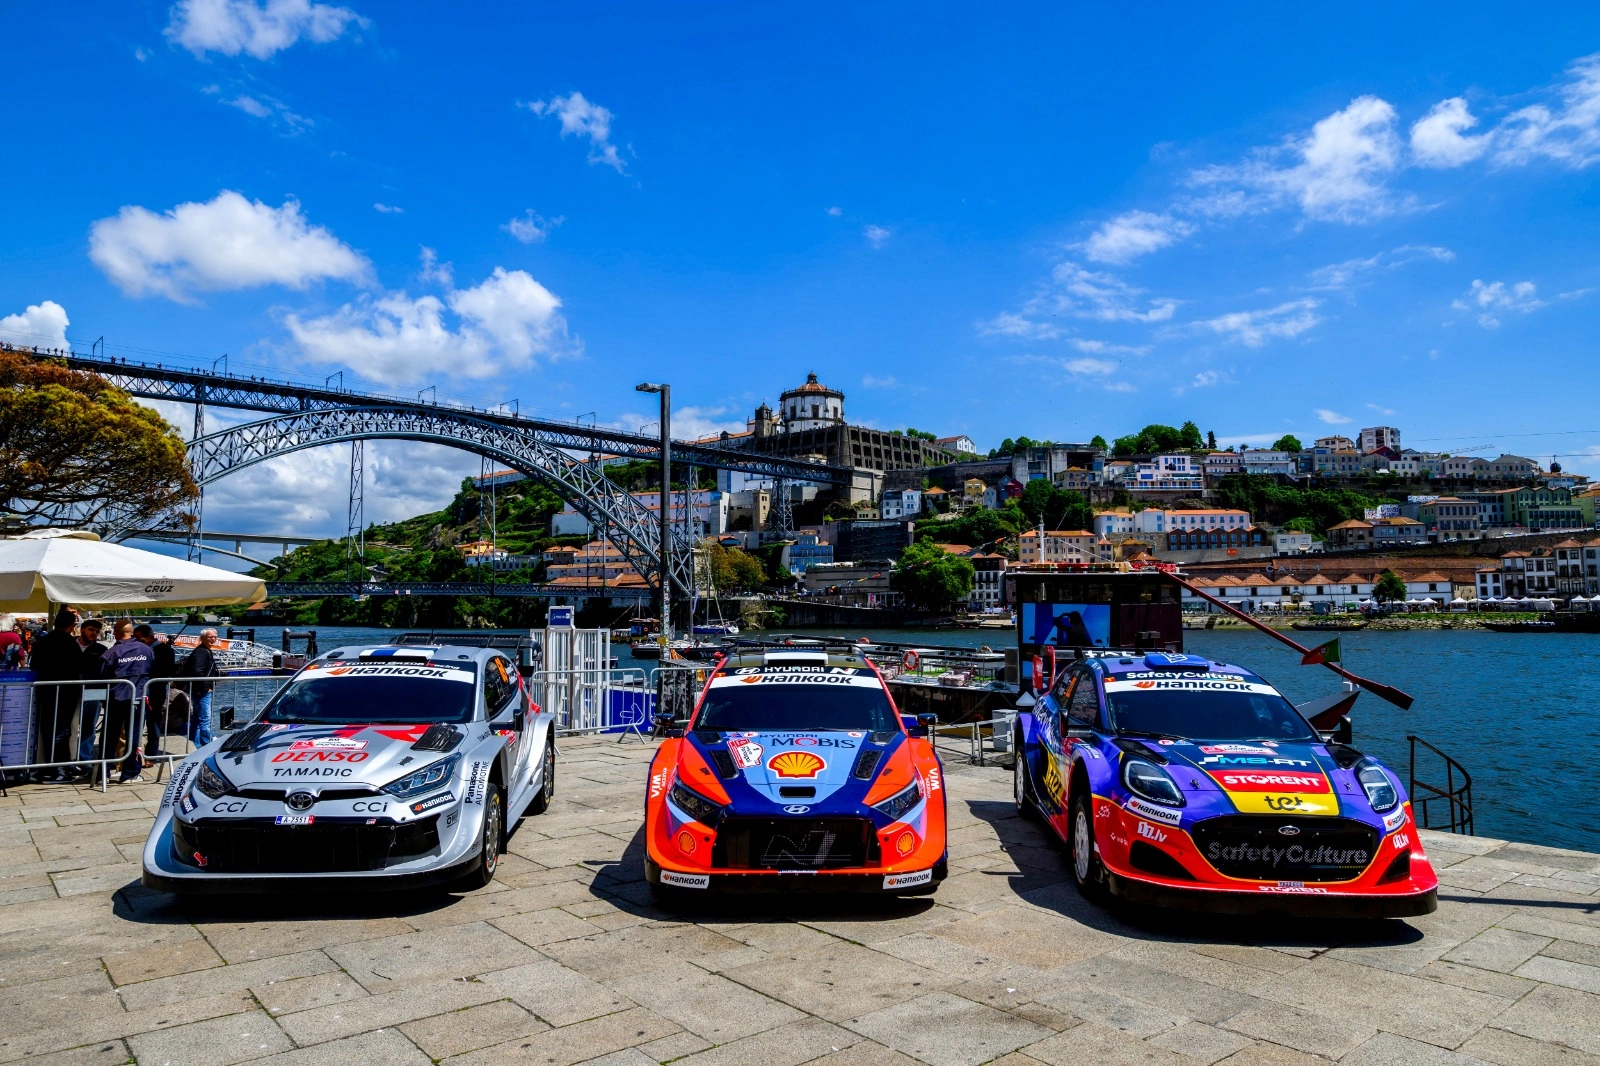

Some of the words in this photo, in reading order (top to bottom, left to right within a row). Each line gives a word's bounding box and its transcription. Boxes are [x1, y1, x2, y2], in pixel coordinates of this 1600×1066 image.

[144, 585, 175, 593] CRUZ
[1126, 671, 1244, 681] SafetyCulture
[771, 738, 856, 750] MOBIS
[271, 751, 369, 763] DENSO
[273, 767, 353, 777] TAMADIC
[171, 761, 199, 807] Panasonic
[464, 761, 481, 804] Panasonic
[475, 761, 490, 806] AUTOMOTIVE
[1223, 774, 1320, 786] STORENT
[1207, 842, 1368, 868] SafetyCulture
